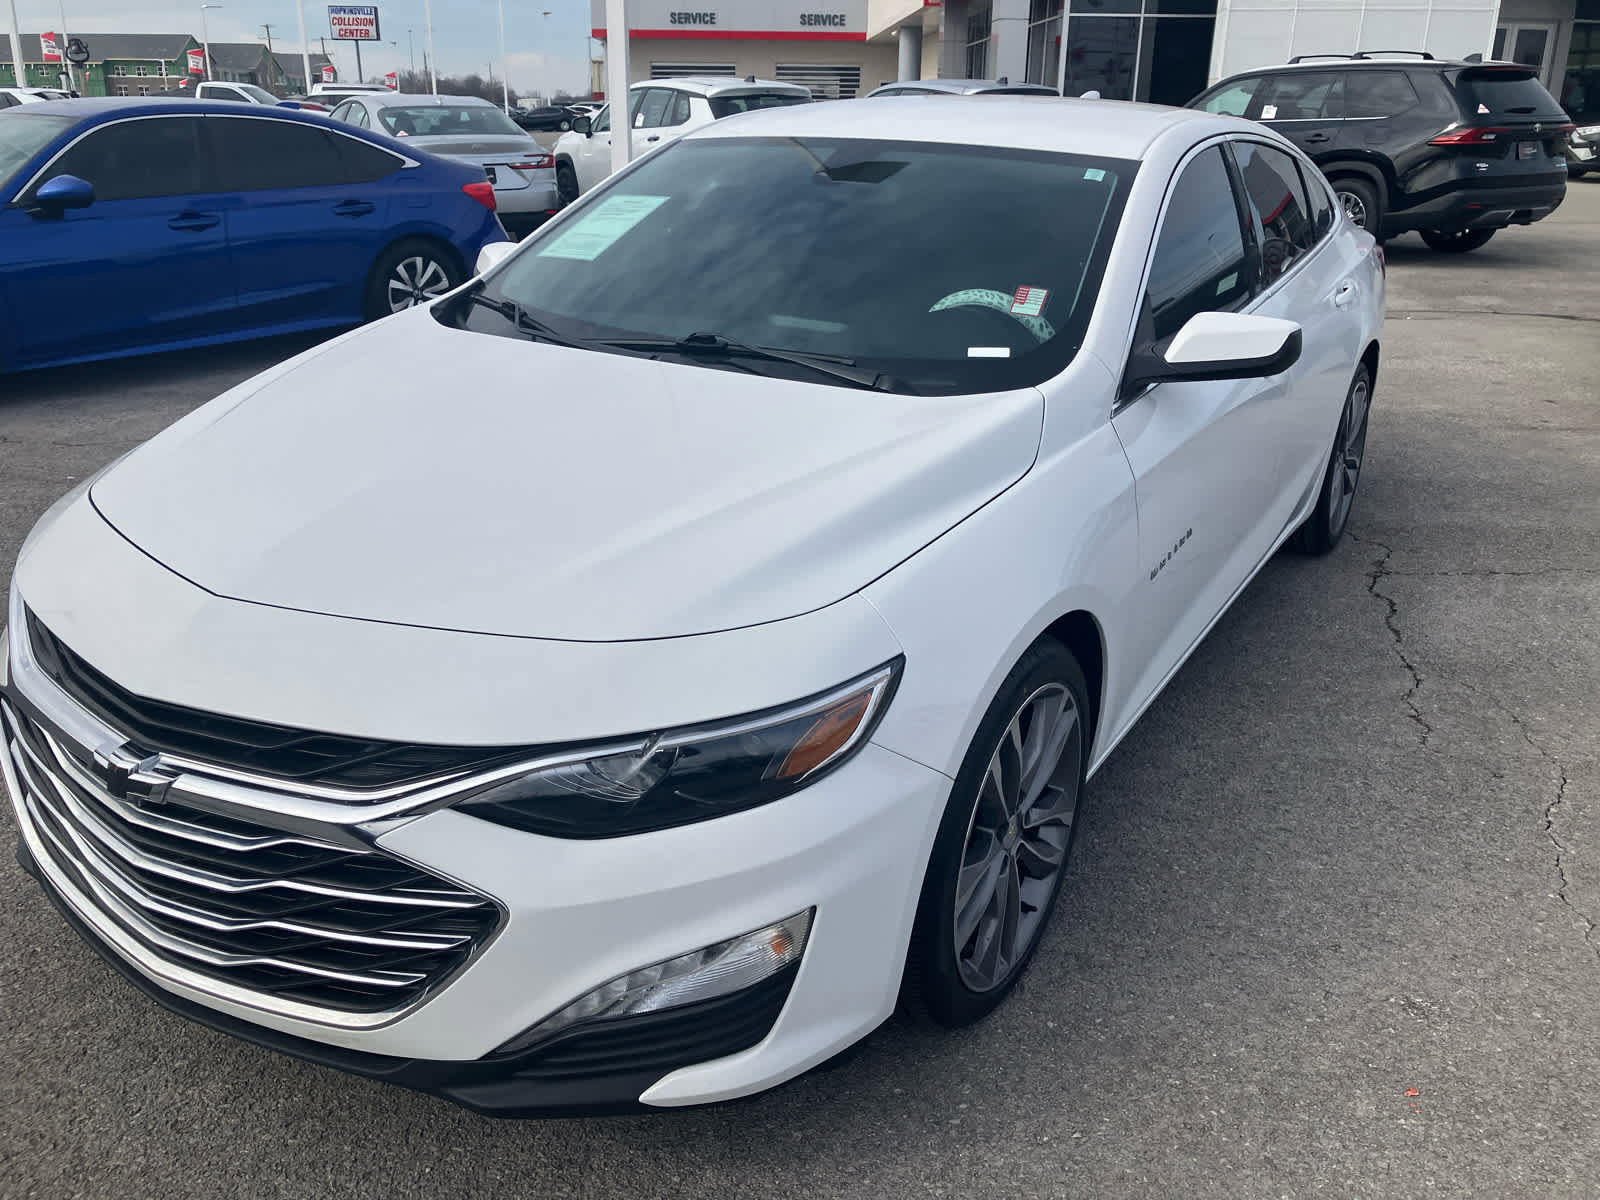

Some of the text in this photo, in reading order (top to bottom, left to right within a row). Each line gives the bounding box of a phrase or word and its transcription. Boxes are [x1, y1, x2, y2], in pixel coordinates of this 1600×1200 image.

[331, 16, 374, 27] COLLISION
[670, 12, 716, 25] SERVICE
[800, 14, 846, 26] SERVICE
[338, 28, 370, 38] CENTER
